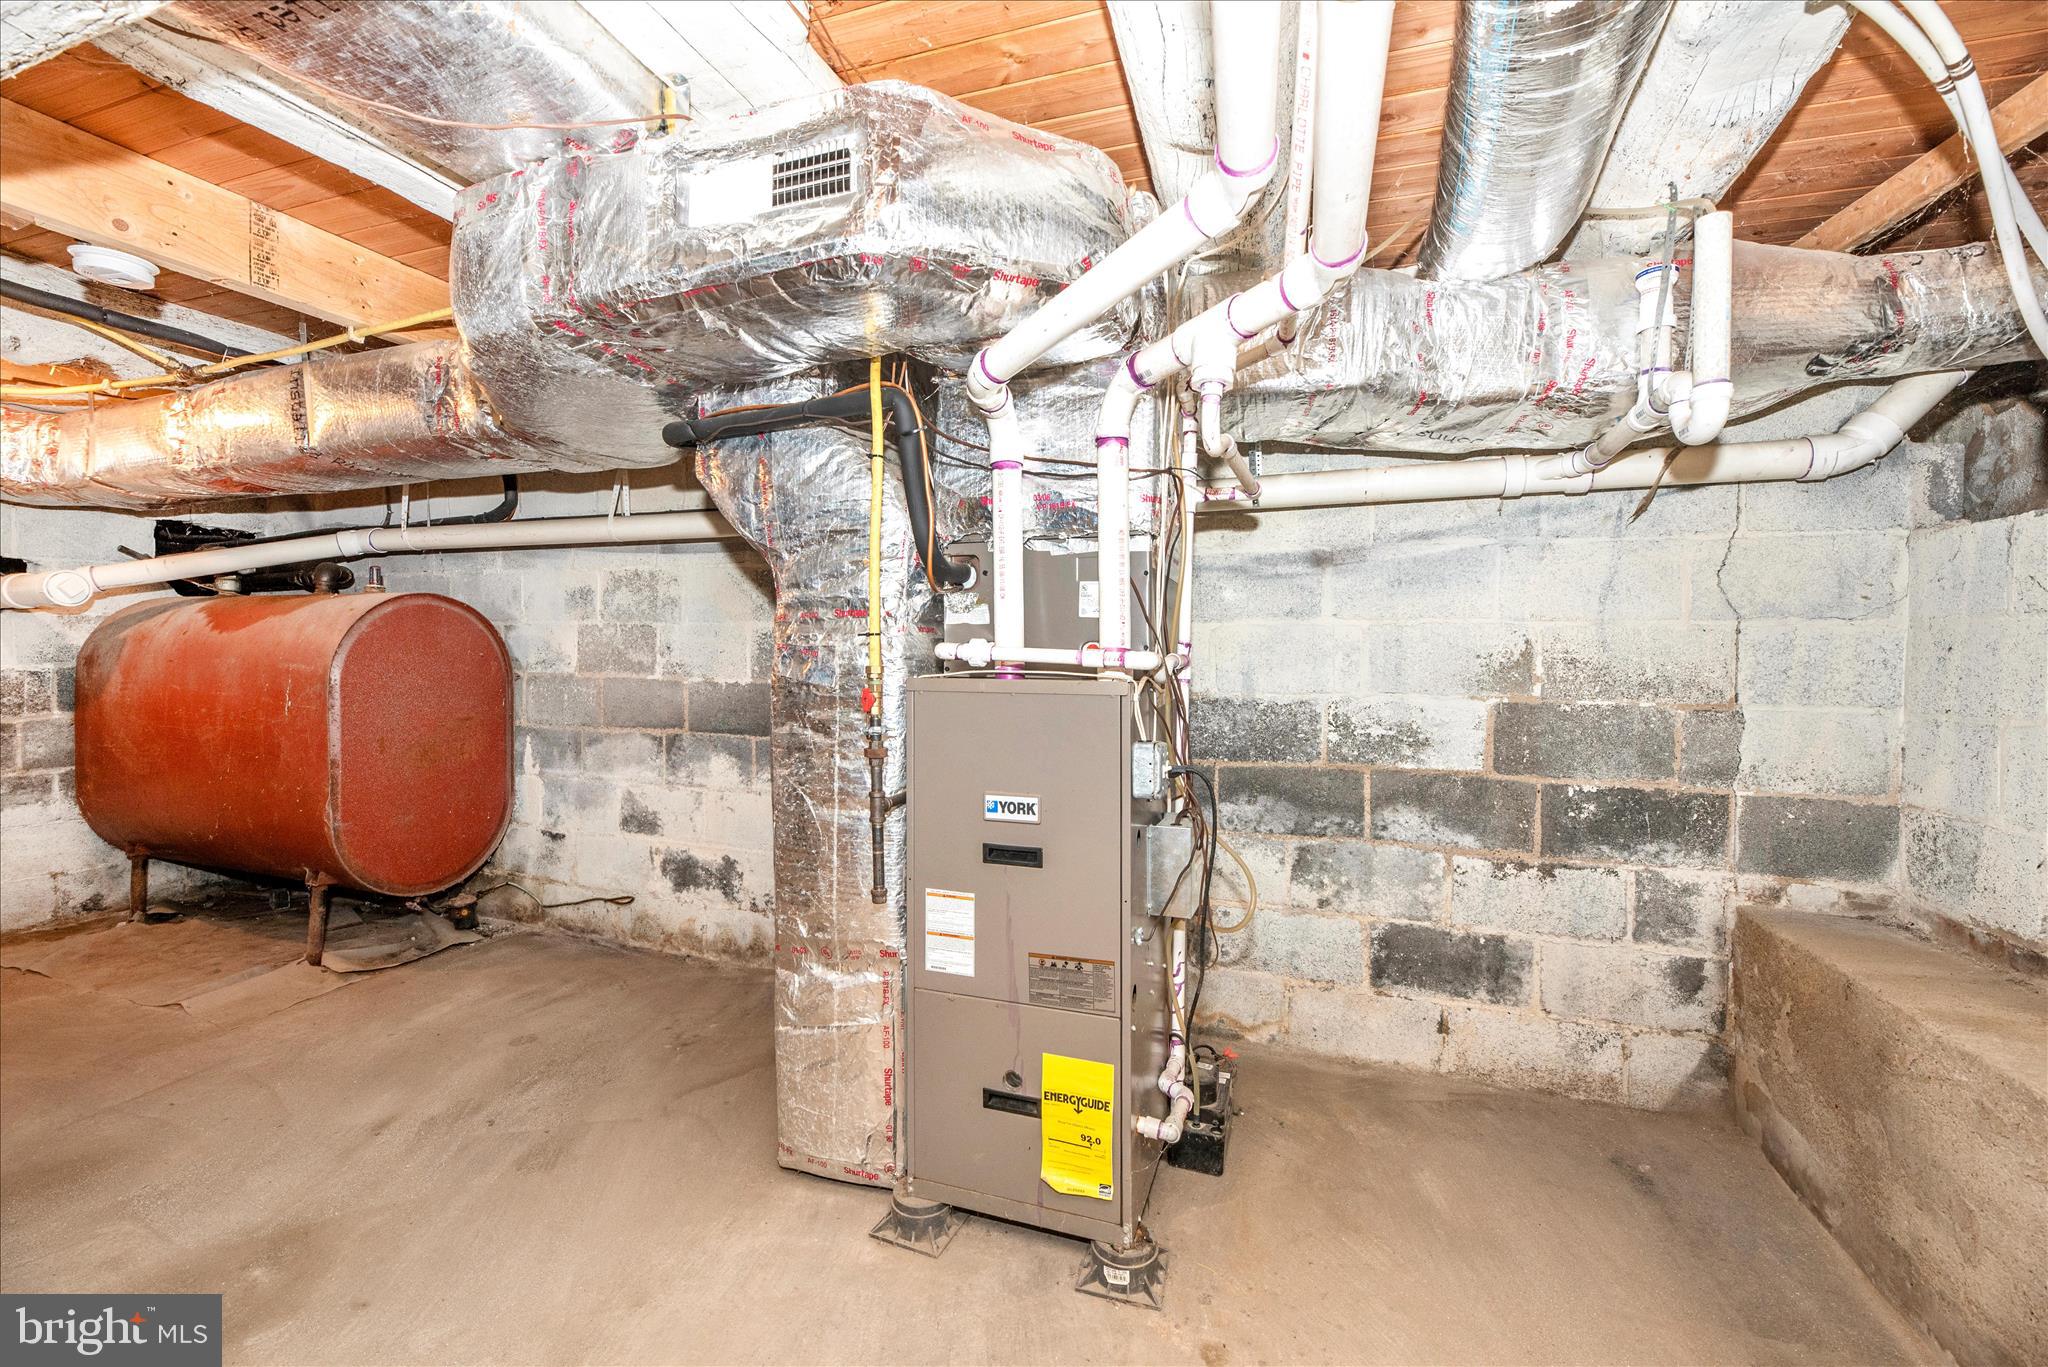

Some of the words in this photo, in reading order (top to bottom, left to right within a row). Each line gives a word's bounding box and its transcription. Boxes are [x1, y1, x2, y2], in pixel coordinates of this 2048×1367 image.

[1294, 65, 1312, 154] CHARLOTTE
[1011, 130, 1057, 153] Shurtape
[1291, 160, 1304, 194] PIPE
[993, 269, 1040, 289] Shurtape
[998, 800, 1037, 816] YORK
[883, 1067, 893, 1107] Shurtape
[1043, 1090, 1111, 1114] ENERGYGUIDE
[1079, 1132, 1102, 1146] 92.0
[843, 1165, 881, 1181] Shurtape
